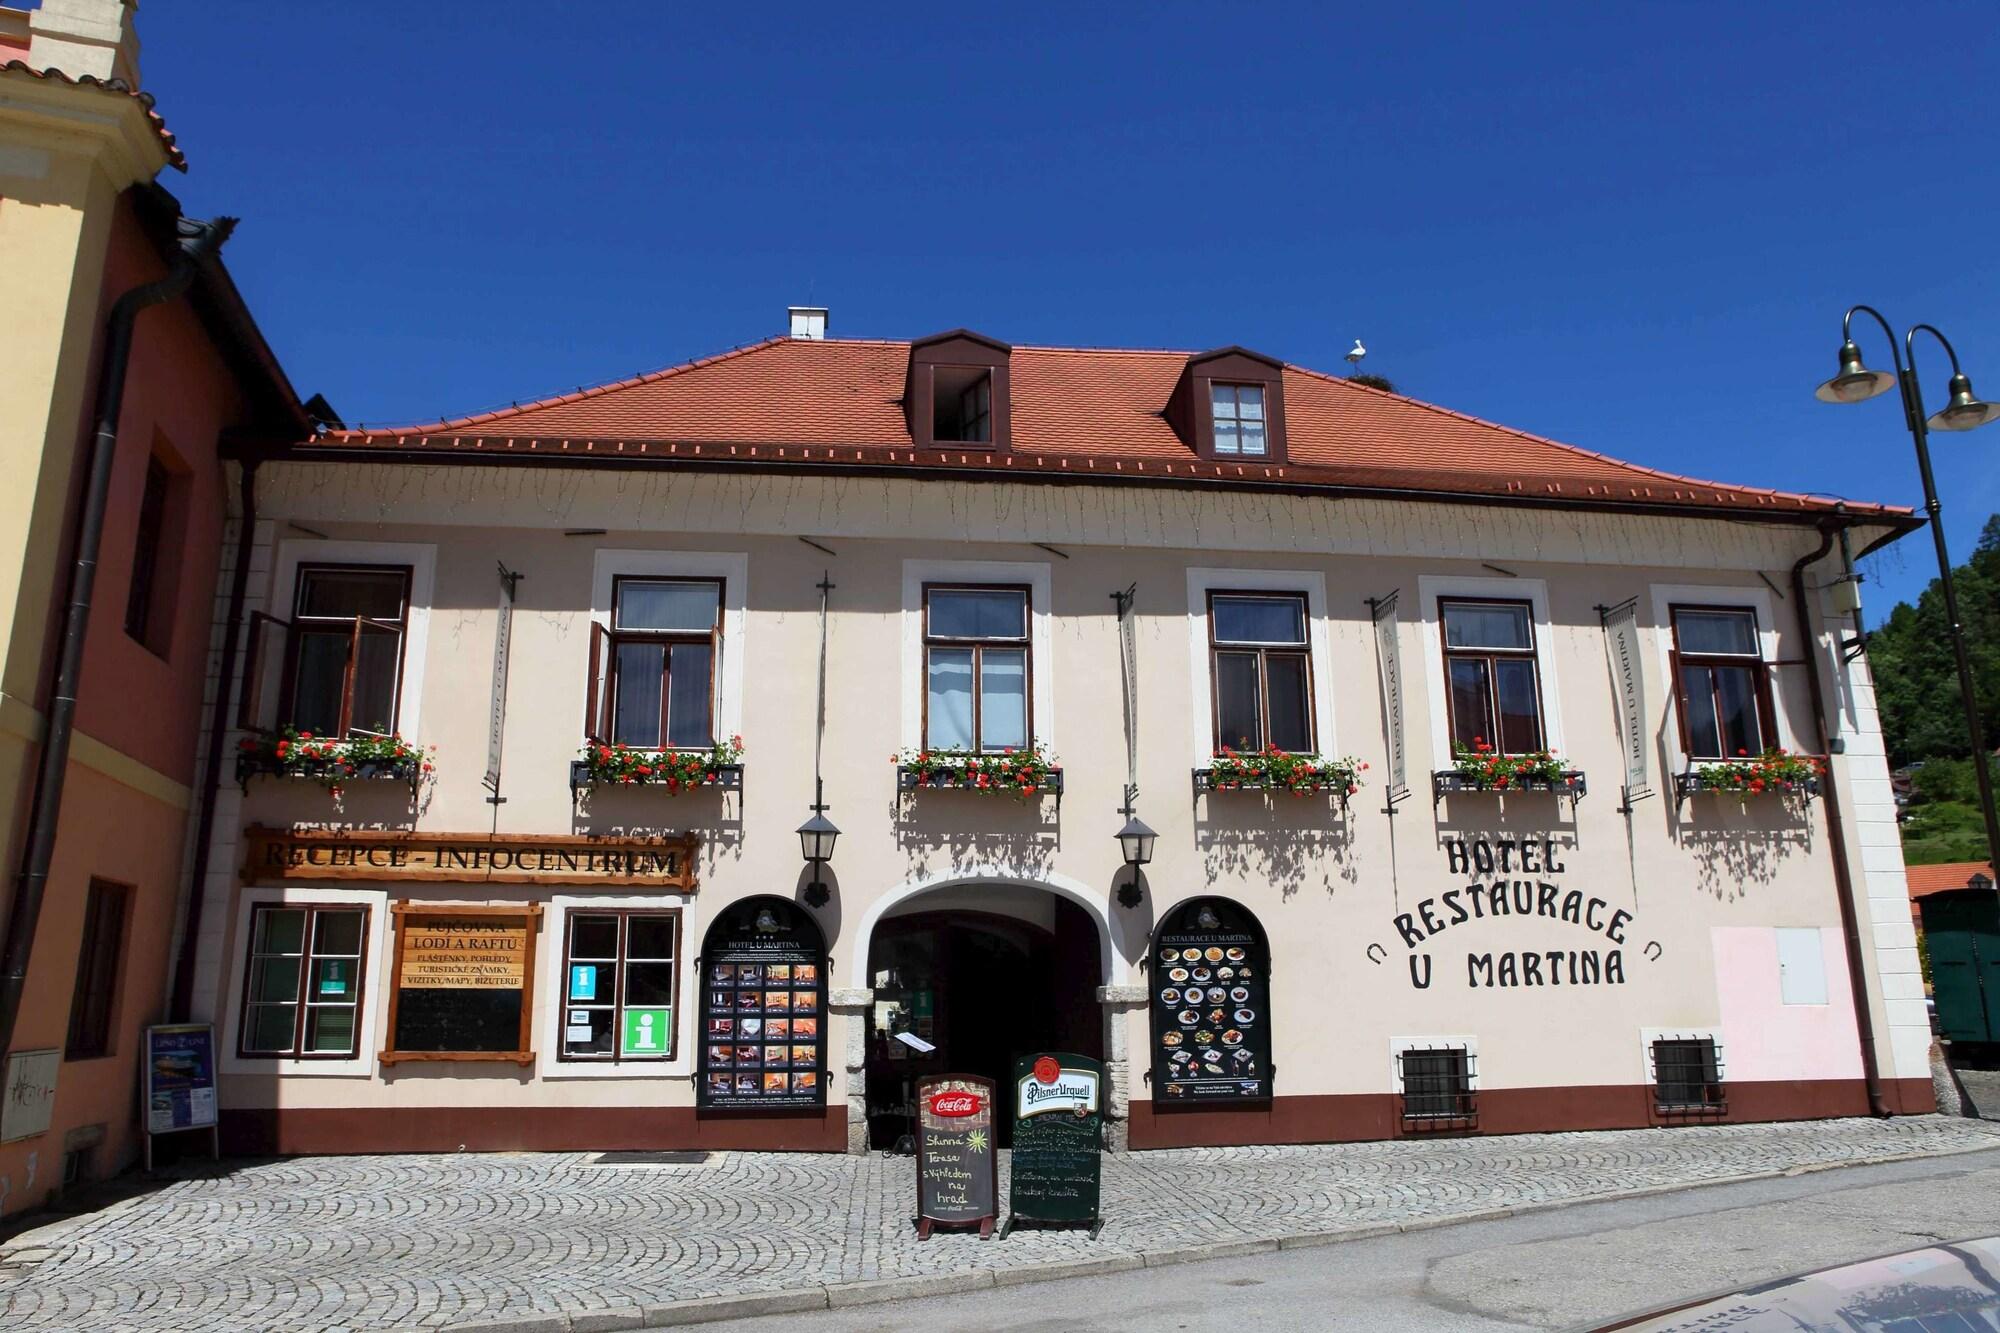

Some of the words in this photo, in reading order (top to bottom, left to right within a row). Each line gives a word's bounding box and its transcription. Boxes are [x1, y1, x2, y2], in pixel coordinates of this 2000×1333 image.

[1617, 631, 1634, 695] MARTINA
[1386, 653, 1401, 761] RESTAURACE
[1629, 711, 1640, 759] HOTEL
[266, 842, 407, 867] RECEPCE
[433, 845, 677, 874] INFOCENTRUM
[1447, 839, 1565, 874] HOTEL
[1393, 880, 1634, 949] RESTAURACE
[455, 939, 465, 950] A
[728, 941, 755, 949] HOTEL
[763, 941, 800, 949] MARTINA
[1162, 934, 1210, 942] RESTAURACE
[1409, 953, 1432, 989] U
[1468, 950, 1625, 988] MARTINA
[1027, 1081, 1060, 1105] Pilsner
[1058, 1082, 1090, 1100] Urquell
[926, 1134, 965, 1147] Slunná
[925, 1151, 961, 1163] Terasa
[937, 1191, 969, 1204] hrad
[948, 1182, 966, 1191] na
